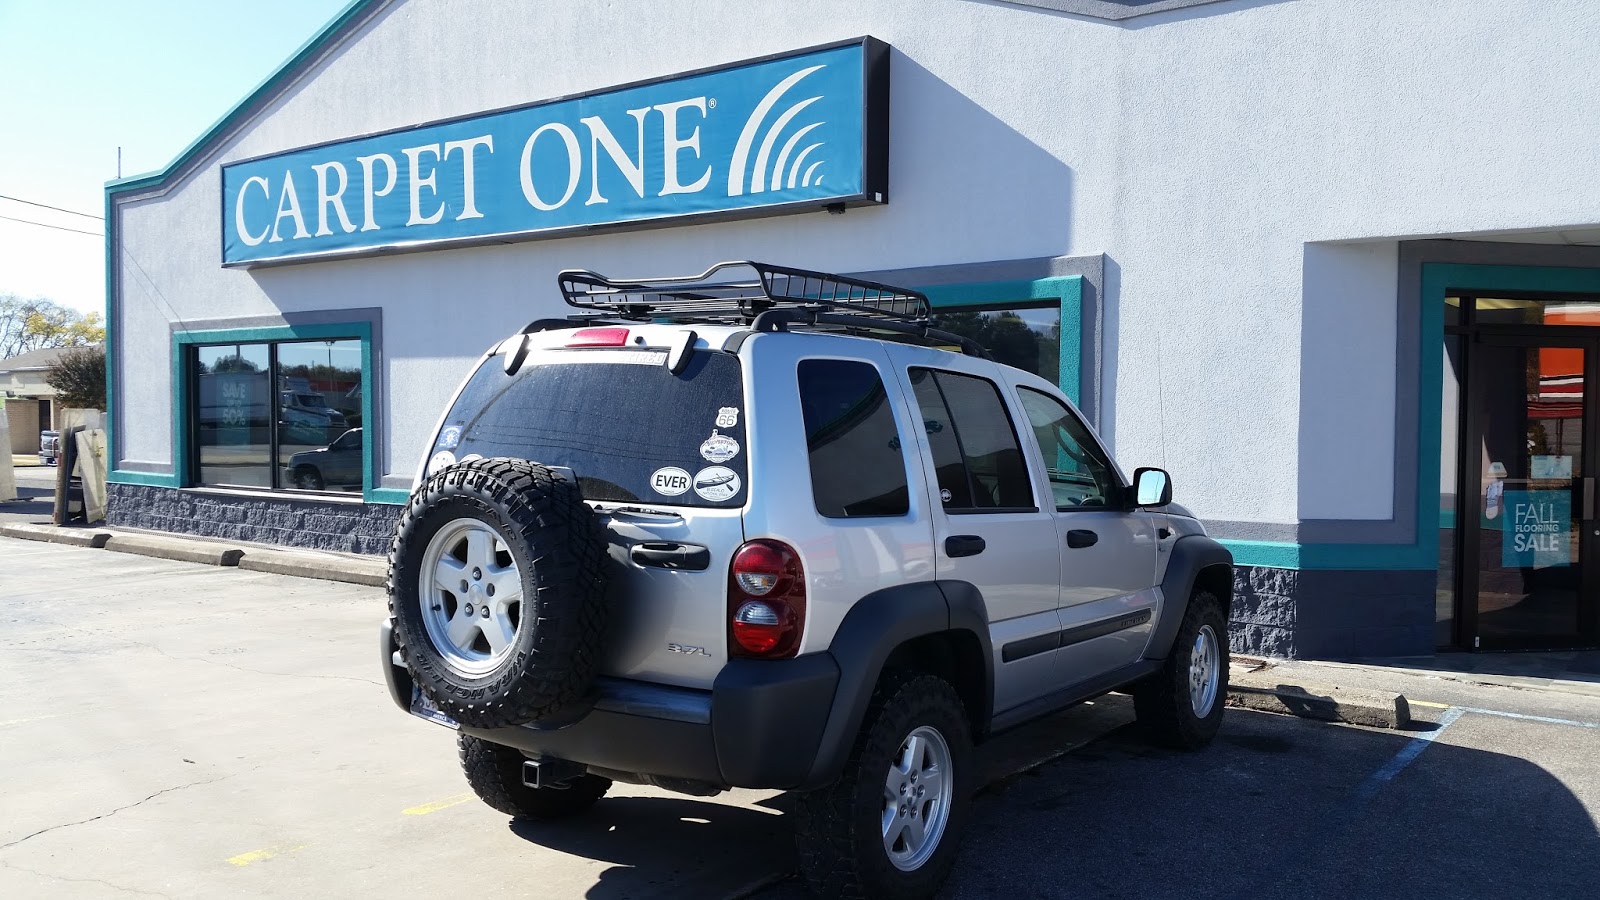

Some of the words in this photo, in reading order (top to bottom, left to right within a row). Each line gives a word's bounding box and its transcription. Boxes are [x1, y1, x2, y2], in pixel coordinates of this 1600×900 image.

[234, 134, 494, 248] CARPET
[222, 382, 246, 398] SAVE
[222, 408, 246, 426] 50%
[718, 414, 735, 426] 66
[655, 474, 688, 489] EVER
[1515, 503, 1560, 524] FALL
[1515, 524, 1560, 533] FLOORING
[1514, 533, 1560, 552] SALE
